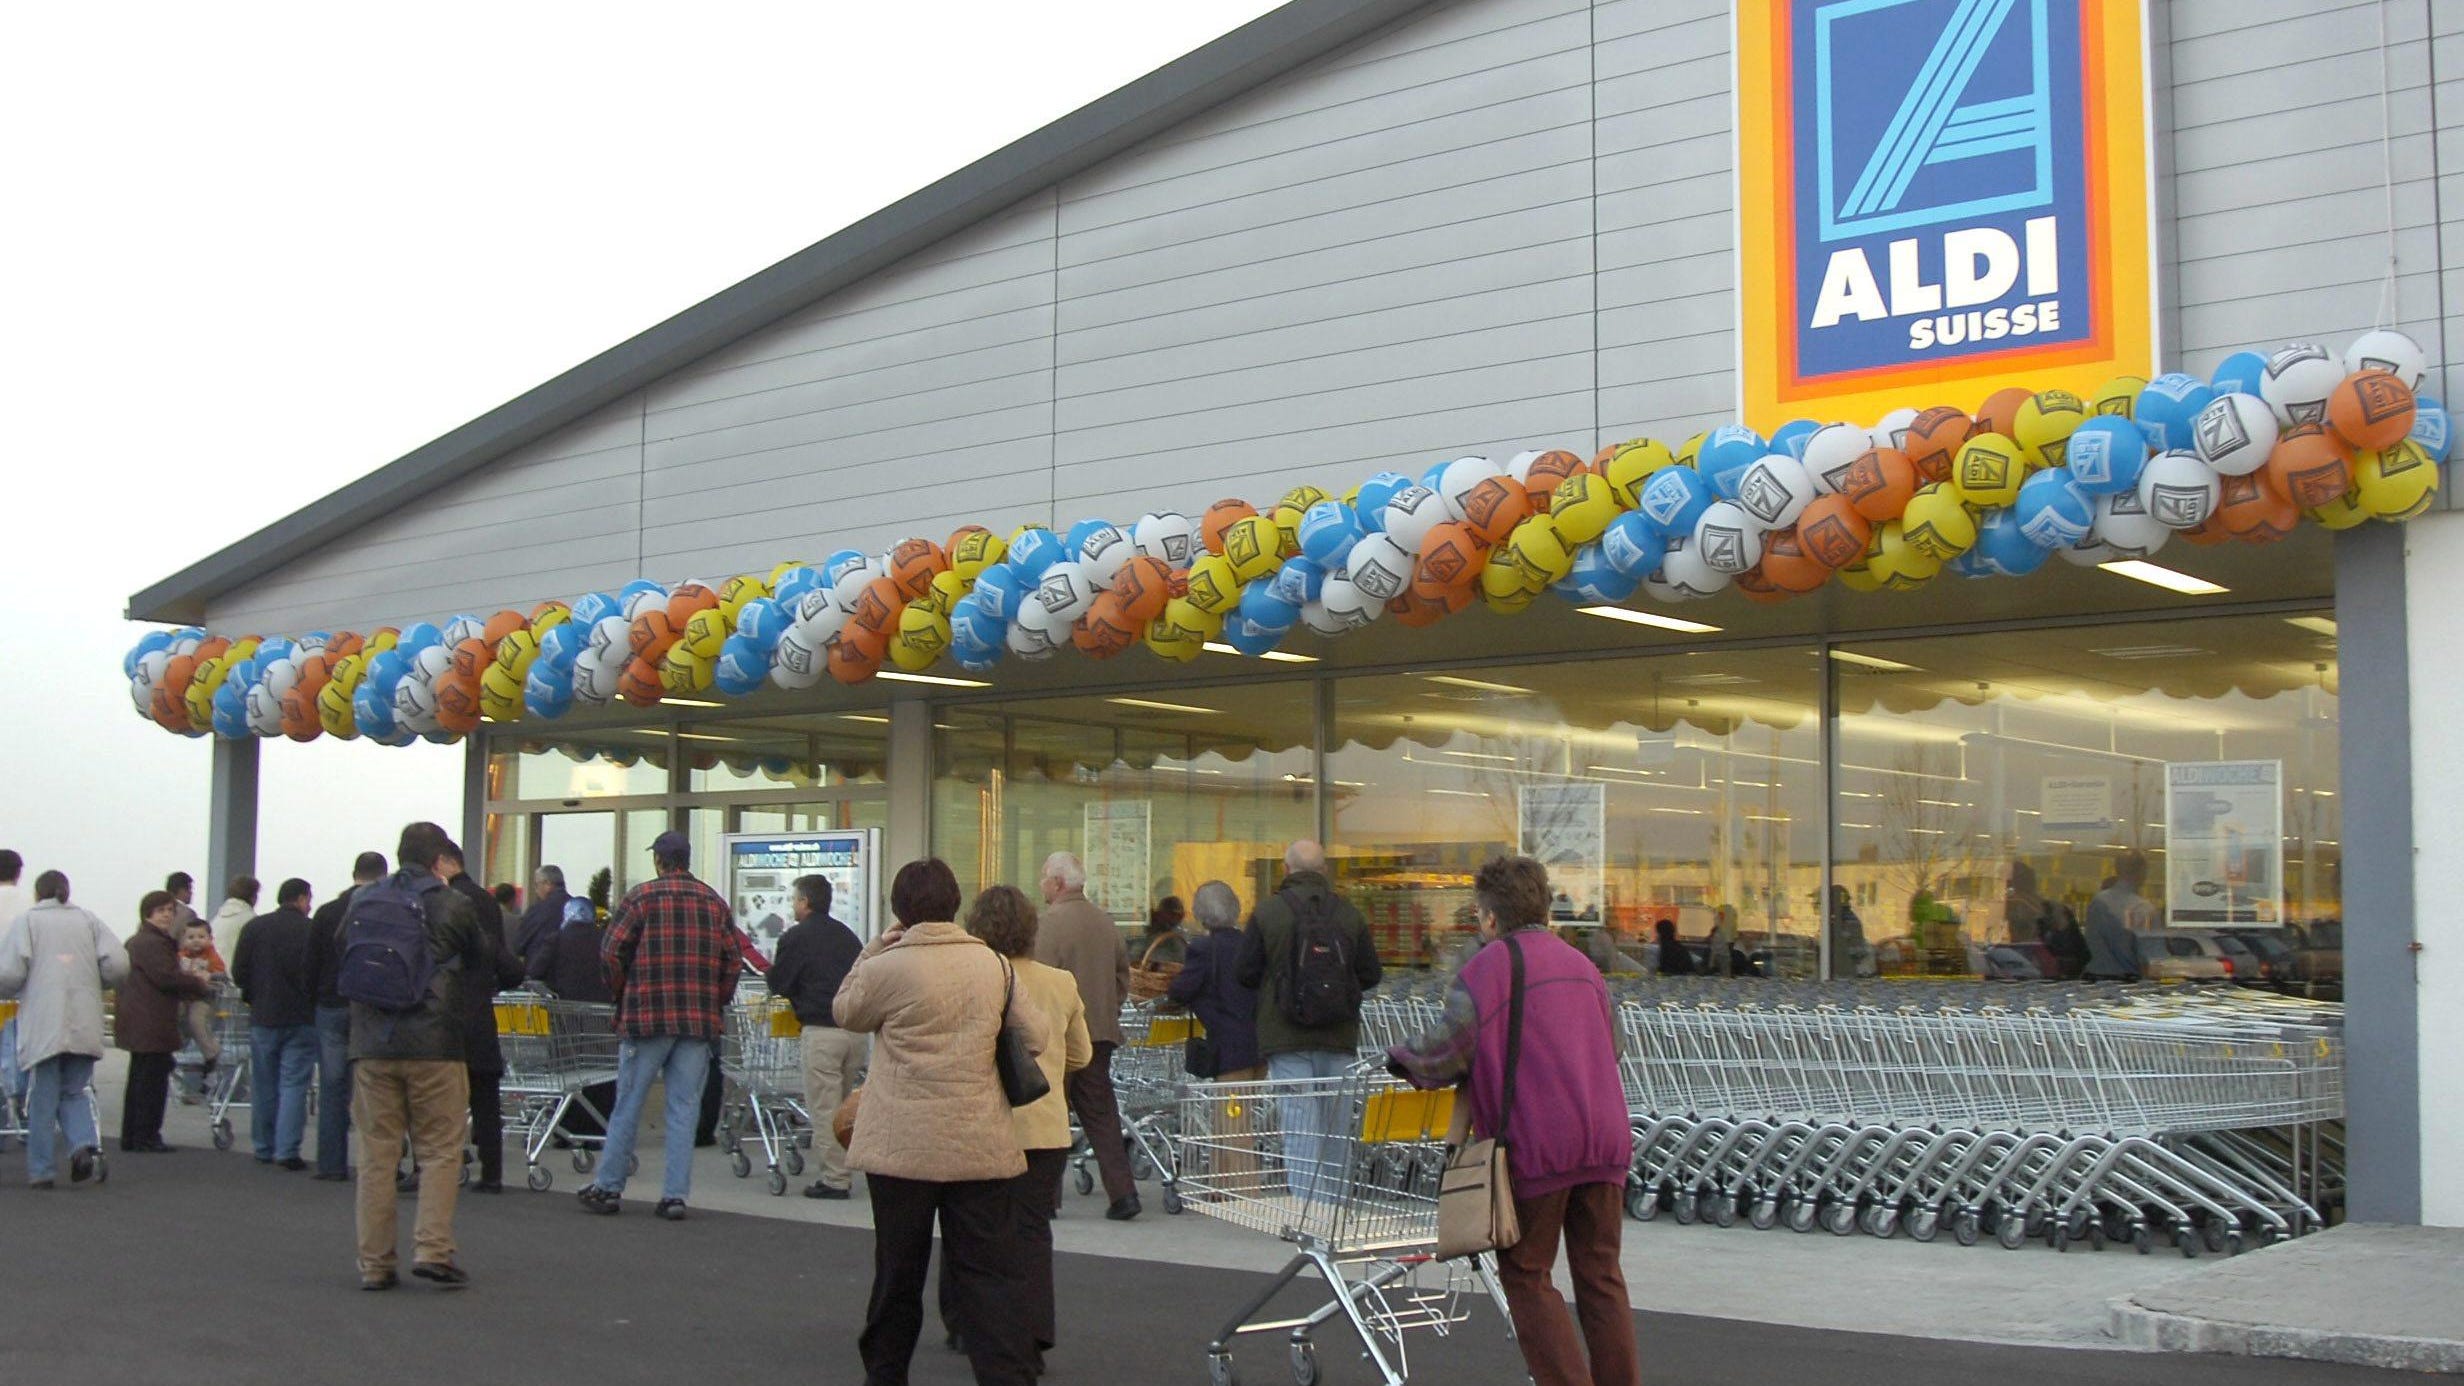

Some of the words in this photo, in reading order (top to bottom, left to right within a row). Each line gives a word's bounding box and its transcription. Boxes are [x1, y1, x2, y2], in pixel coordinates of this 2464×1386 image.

[1810, 215, 2059, 329] ALDI
[1909, 300, 2060, 350] SUISSE
[1971, 455, 1981, 480] ALDI
[1089, 531, 1111, 548] ALDI
